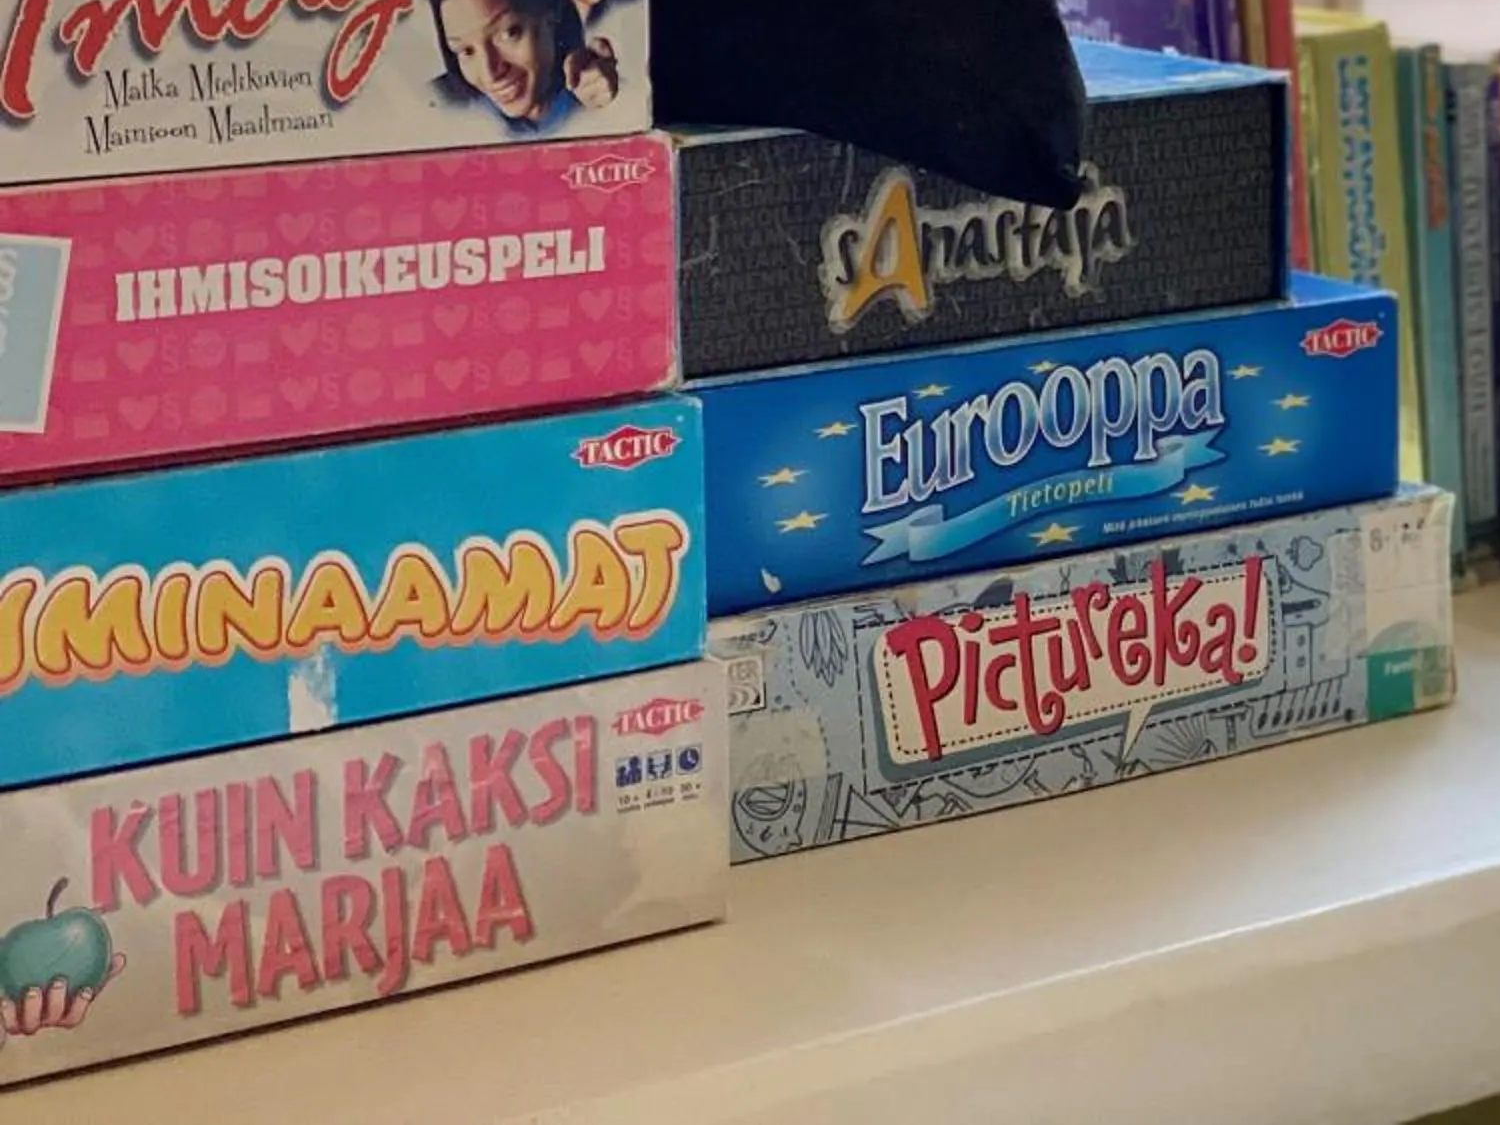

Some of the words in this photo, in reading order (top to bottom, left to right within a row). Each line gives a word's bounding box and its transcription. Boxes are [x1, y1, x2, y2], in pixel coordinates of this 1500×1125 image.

[105, 68, 179, 110] Matka
[189, 61, 312, 103] Mielikuvien
[85, 111, 198, 154] Mainioon
[207, 103, 334, 145] Maailmaan
[569, 159, 646, 187] TACTIC
[114, 225, 607, 322] IHMISOIKEUSPELI
[1305, 323, 1378, 355] TACTIC
[583, 430, 669, 465] TACTIC
[859, 347, 1225, 514] Eurooppa
[1005, 472, 1115, 519] Tietopeli
[885, 554, 1264, 762] Pictureka!
[620, 701, 700, 734] TACTIC
[88, 768, 318, 914] KUIN
[342, 714, 599, 860] KAKSI
[174, 842, 535, 1017] MARJAA
